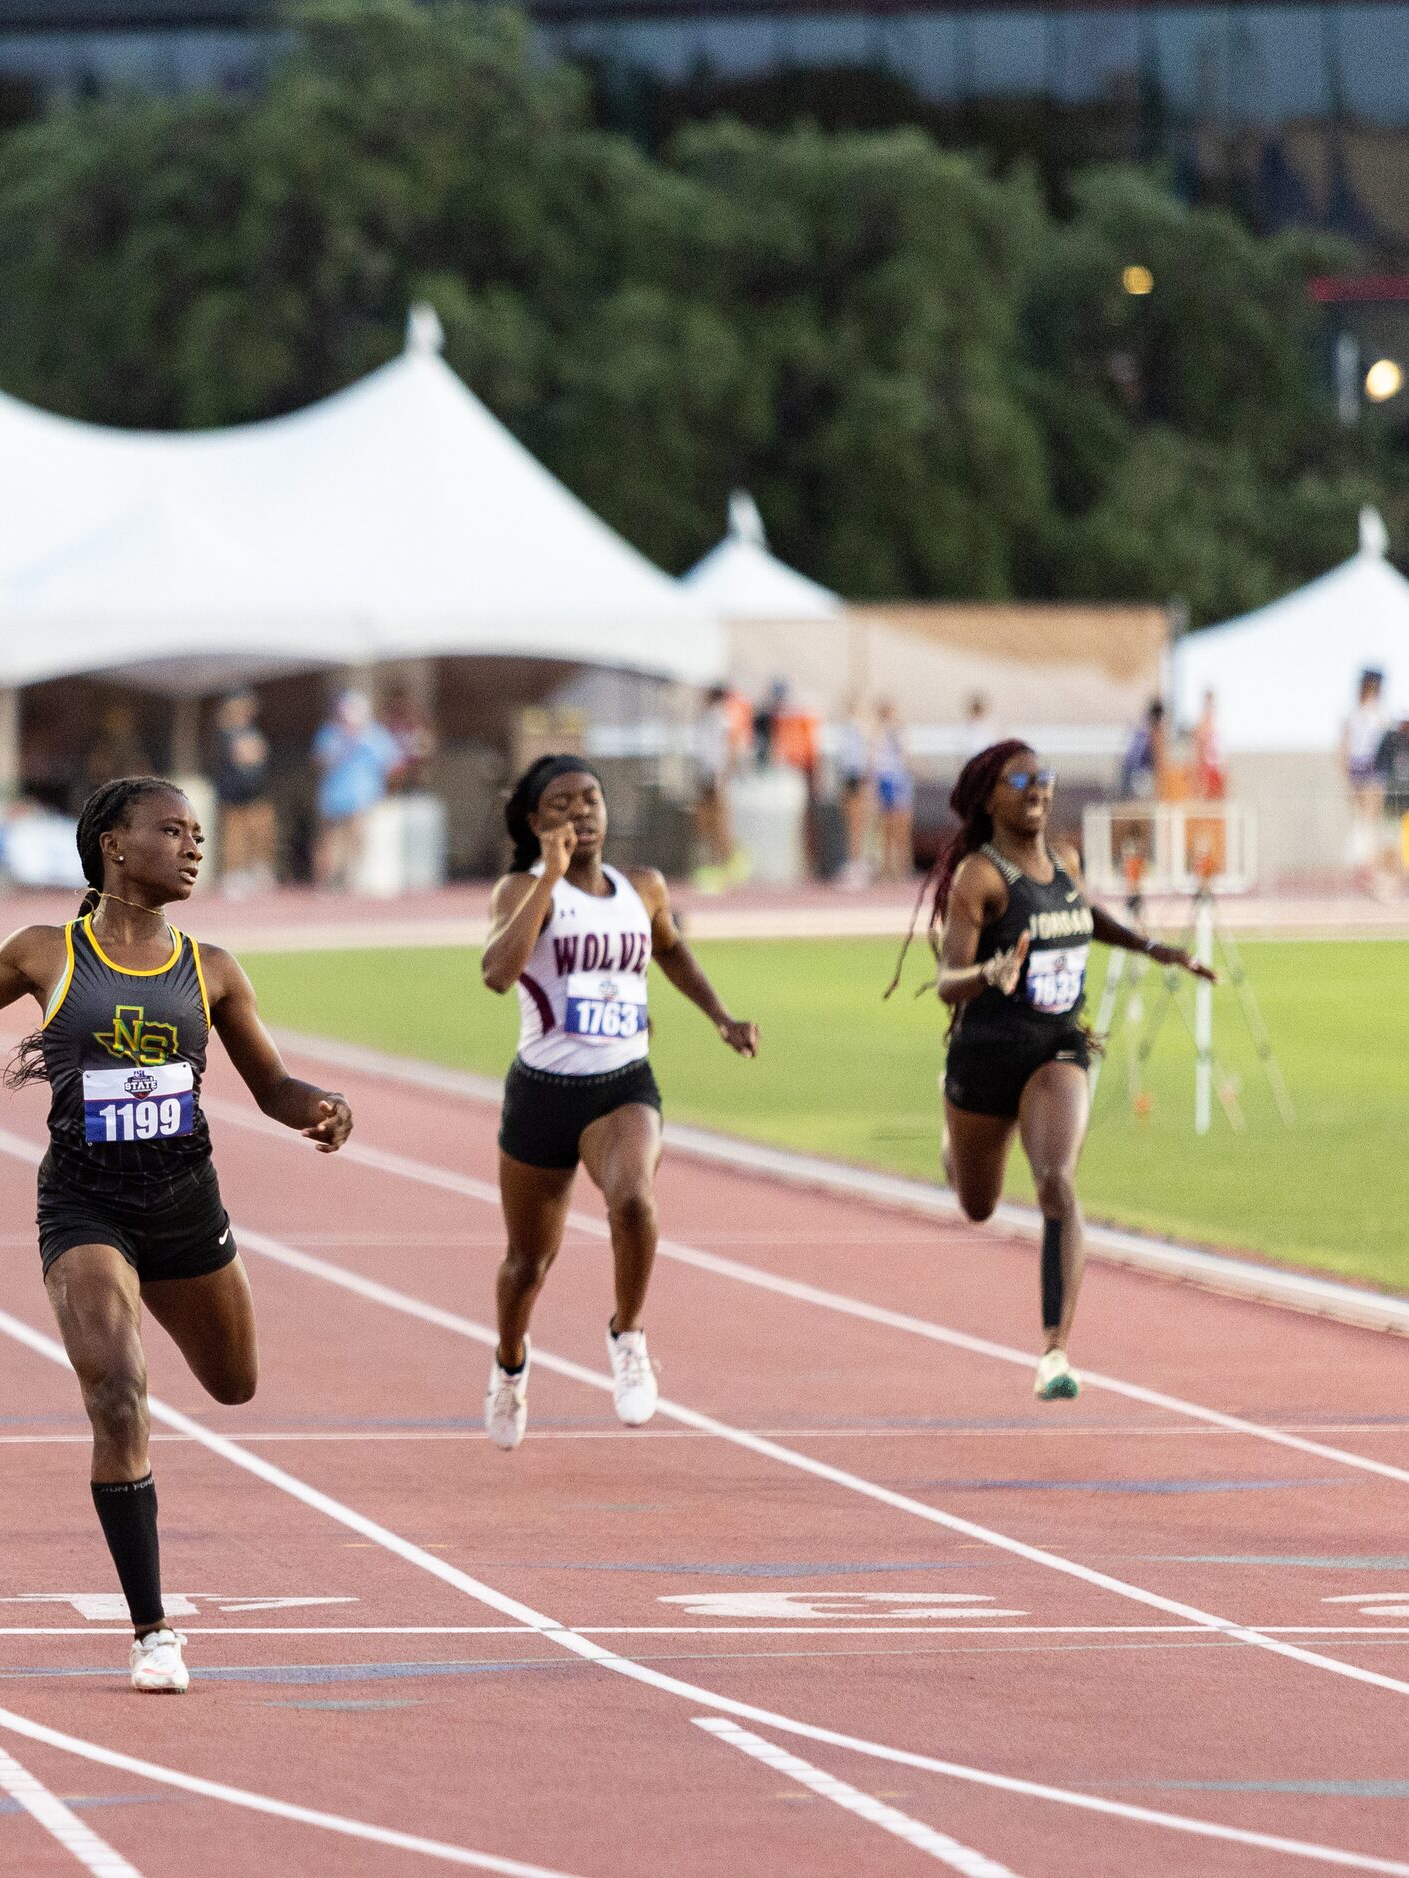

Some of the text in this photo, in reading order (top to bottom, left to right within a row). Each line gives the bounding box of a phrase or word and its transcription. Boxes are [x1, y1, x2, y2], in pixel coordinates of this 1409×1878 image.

[576, 1001, 639, 1037] 1763
[112, 1018, 169, 1066] NS
[124, 1080, 158, 1091] STATE
[99, 1098, 181, 1142] 1199
